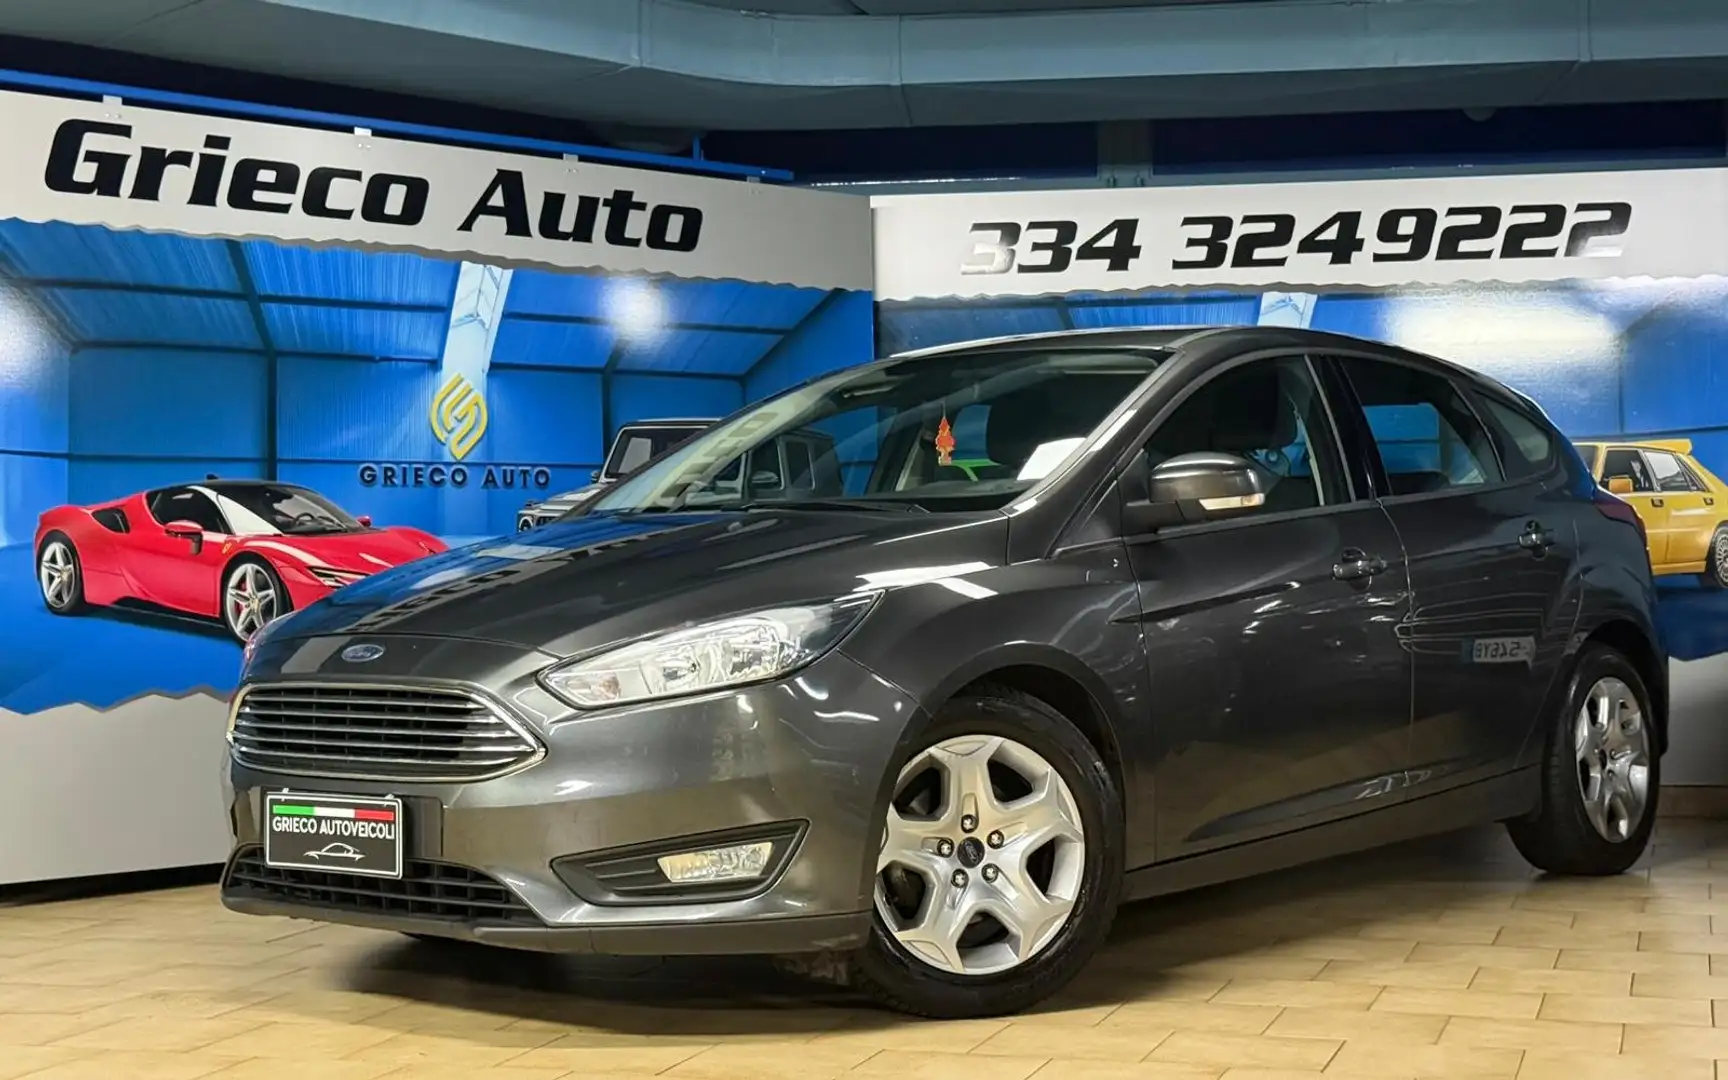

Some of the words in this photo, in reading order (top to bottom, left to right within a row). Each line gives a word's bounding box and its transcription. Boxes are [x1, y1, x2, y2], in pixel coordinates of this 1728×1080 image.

[45, 118, 430, 226] Grieco
[457, 168, 704, 253] Auto
[961, 218, 1142, 275] 334
[1172, 202, 1632, 270] 3249222
[359, 465, 468, 487] GRIECO
[483, 467, 550, 490] AUTO
[272, 816, 317, 834] GRIECO
[319, 819, 395, 840] AUTOVEICOLI
